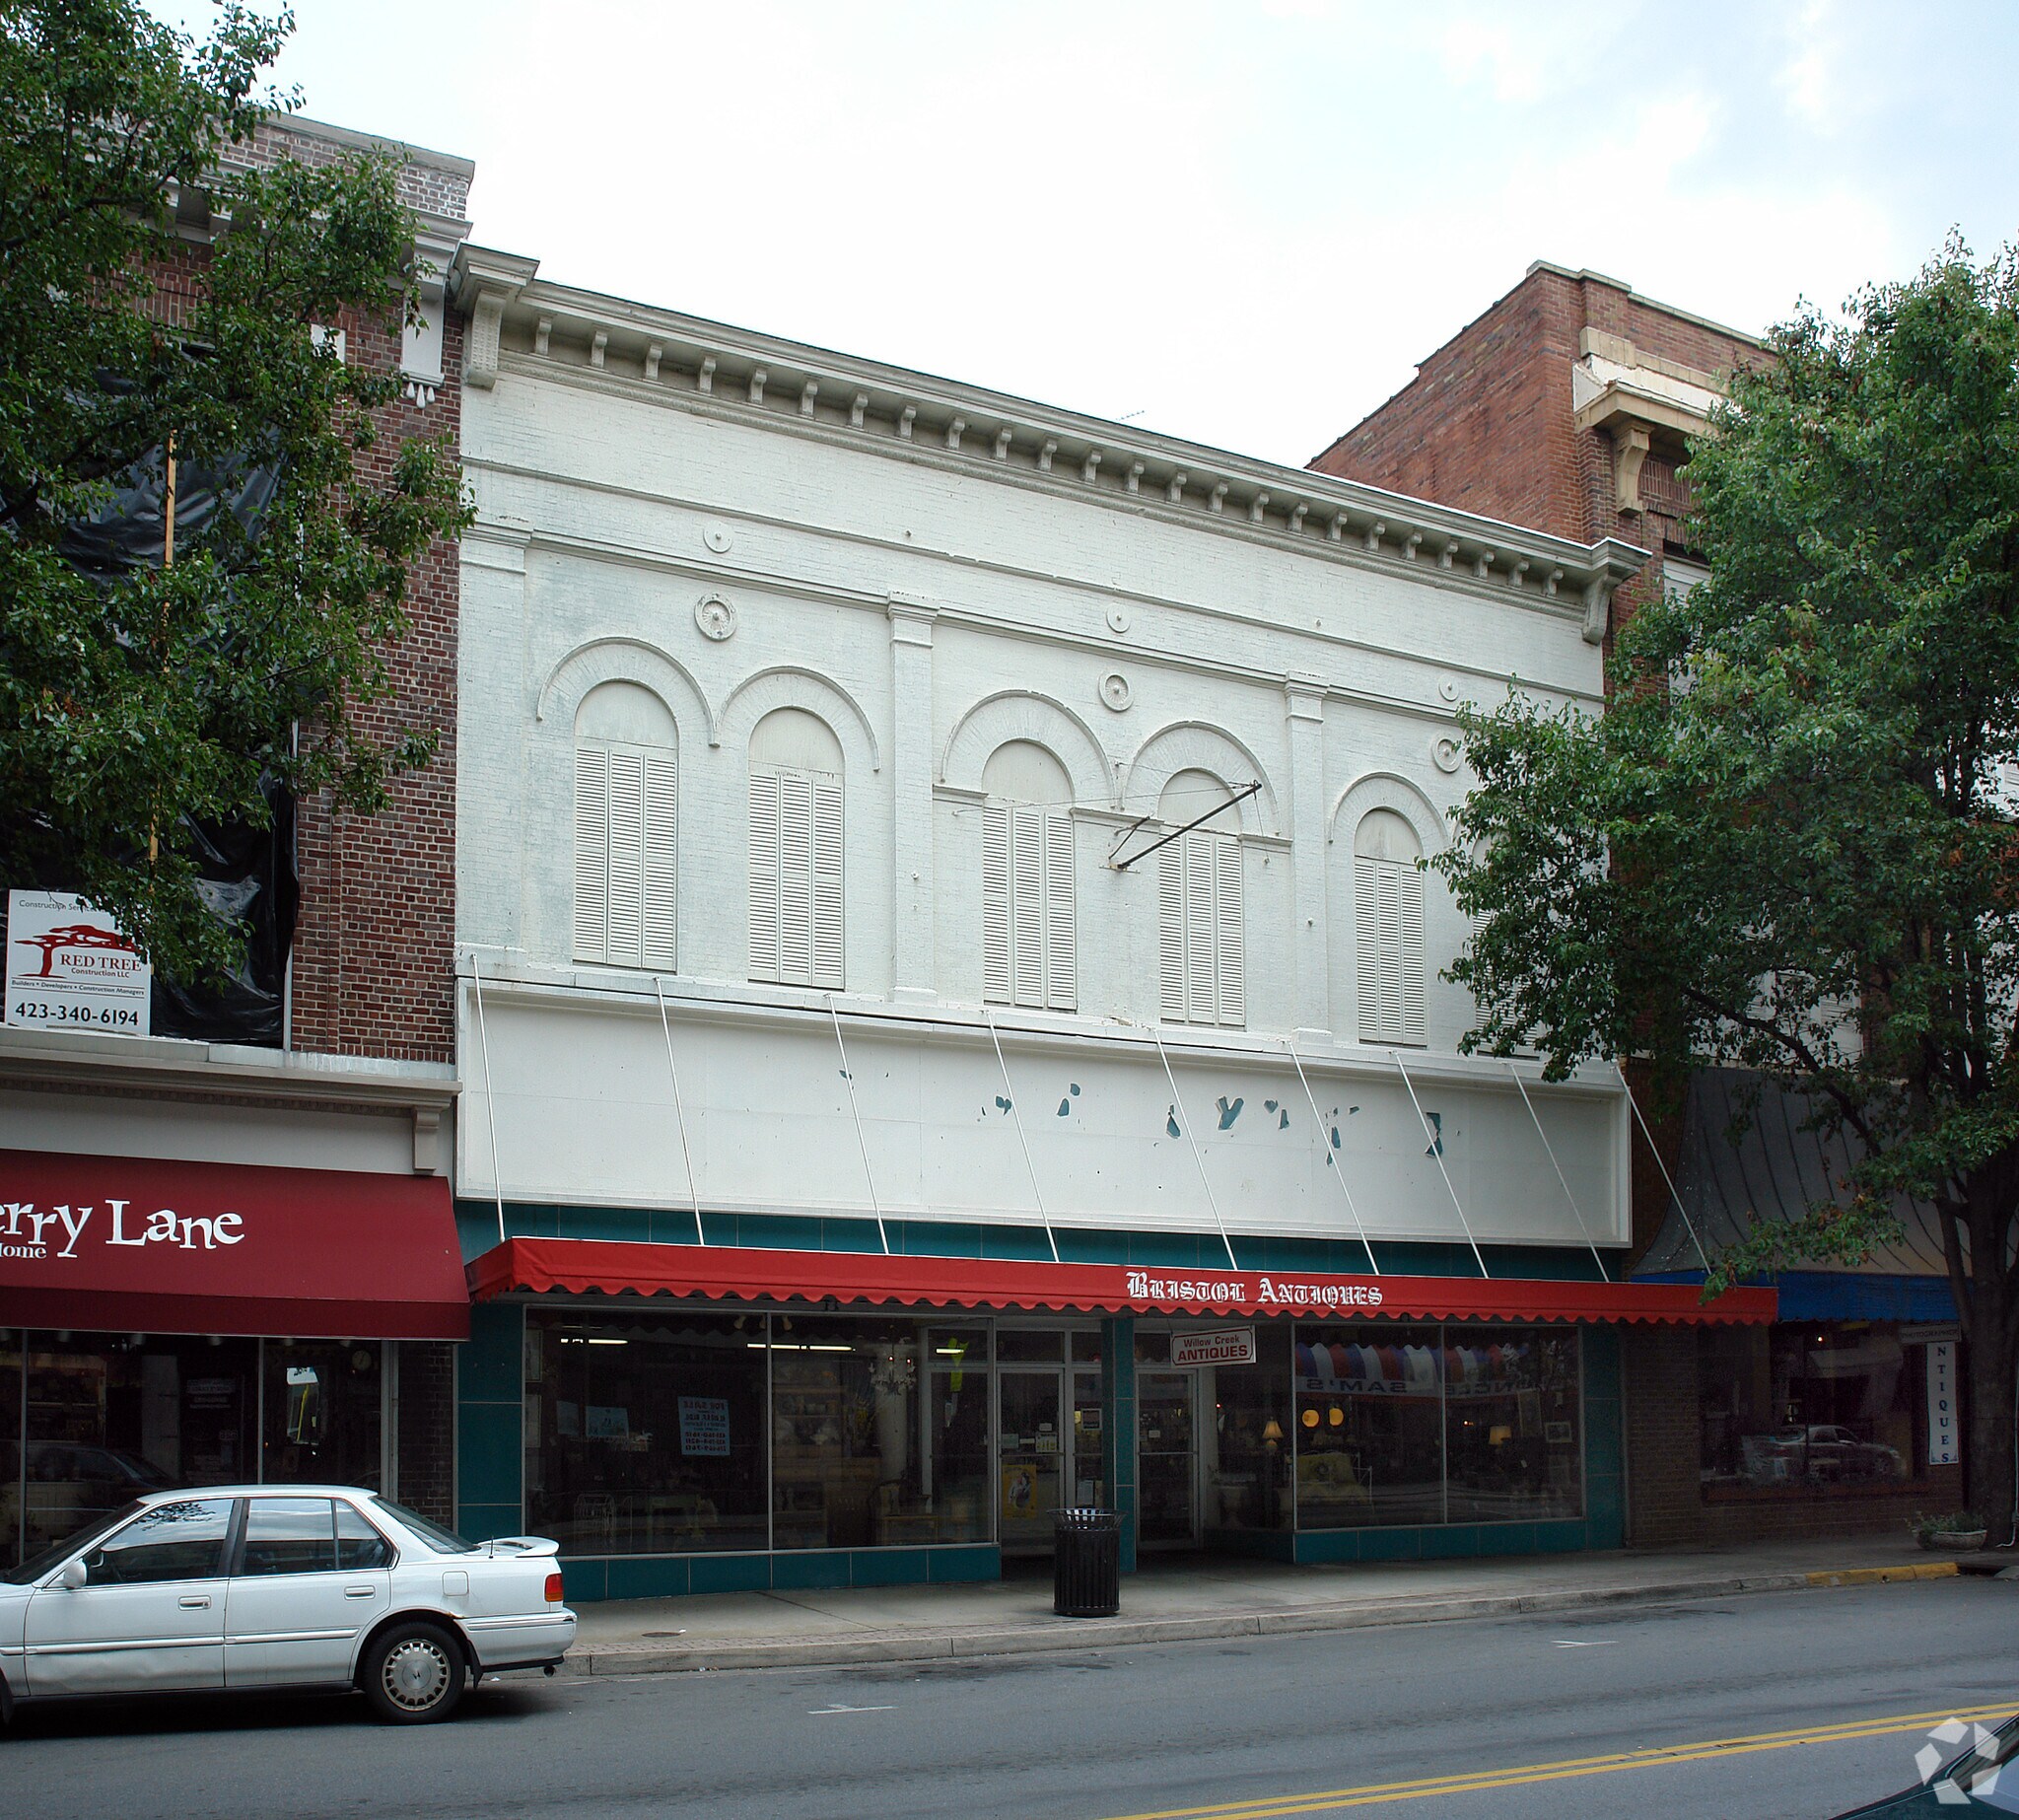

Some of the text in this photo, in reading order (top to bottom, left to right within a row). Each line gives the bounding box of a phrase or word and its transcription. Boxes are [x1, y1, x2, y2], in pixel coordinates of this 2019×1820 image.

[19, 899, 67, 910] Construction
[68, 903, 97, 912] Serice
[60, 953, 142, 971] RED TREE
[71, 967, 116, 977] Construction
[40, 981, 73, 990] Developers
[78, 984, 115, 993] Construction
[115, 987, 145, 996] Managers
[15, 1002, 139, 1026] 423-340-6194
[0, 1199, 245, 1258] rry Lane
[1183, 1334, 1240, 1348] Willow Creek
[1177, 1344, 1248, 1362] ANTIQUES
[1936, 1347, 1950, 1463] NTIQUES
